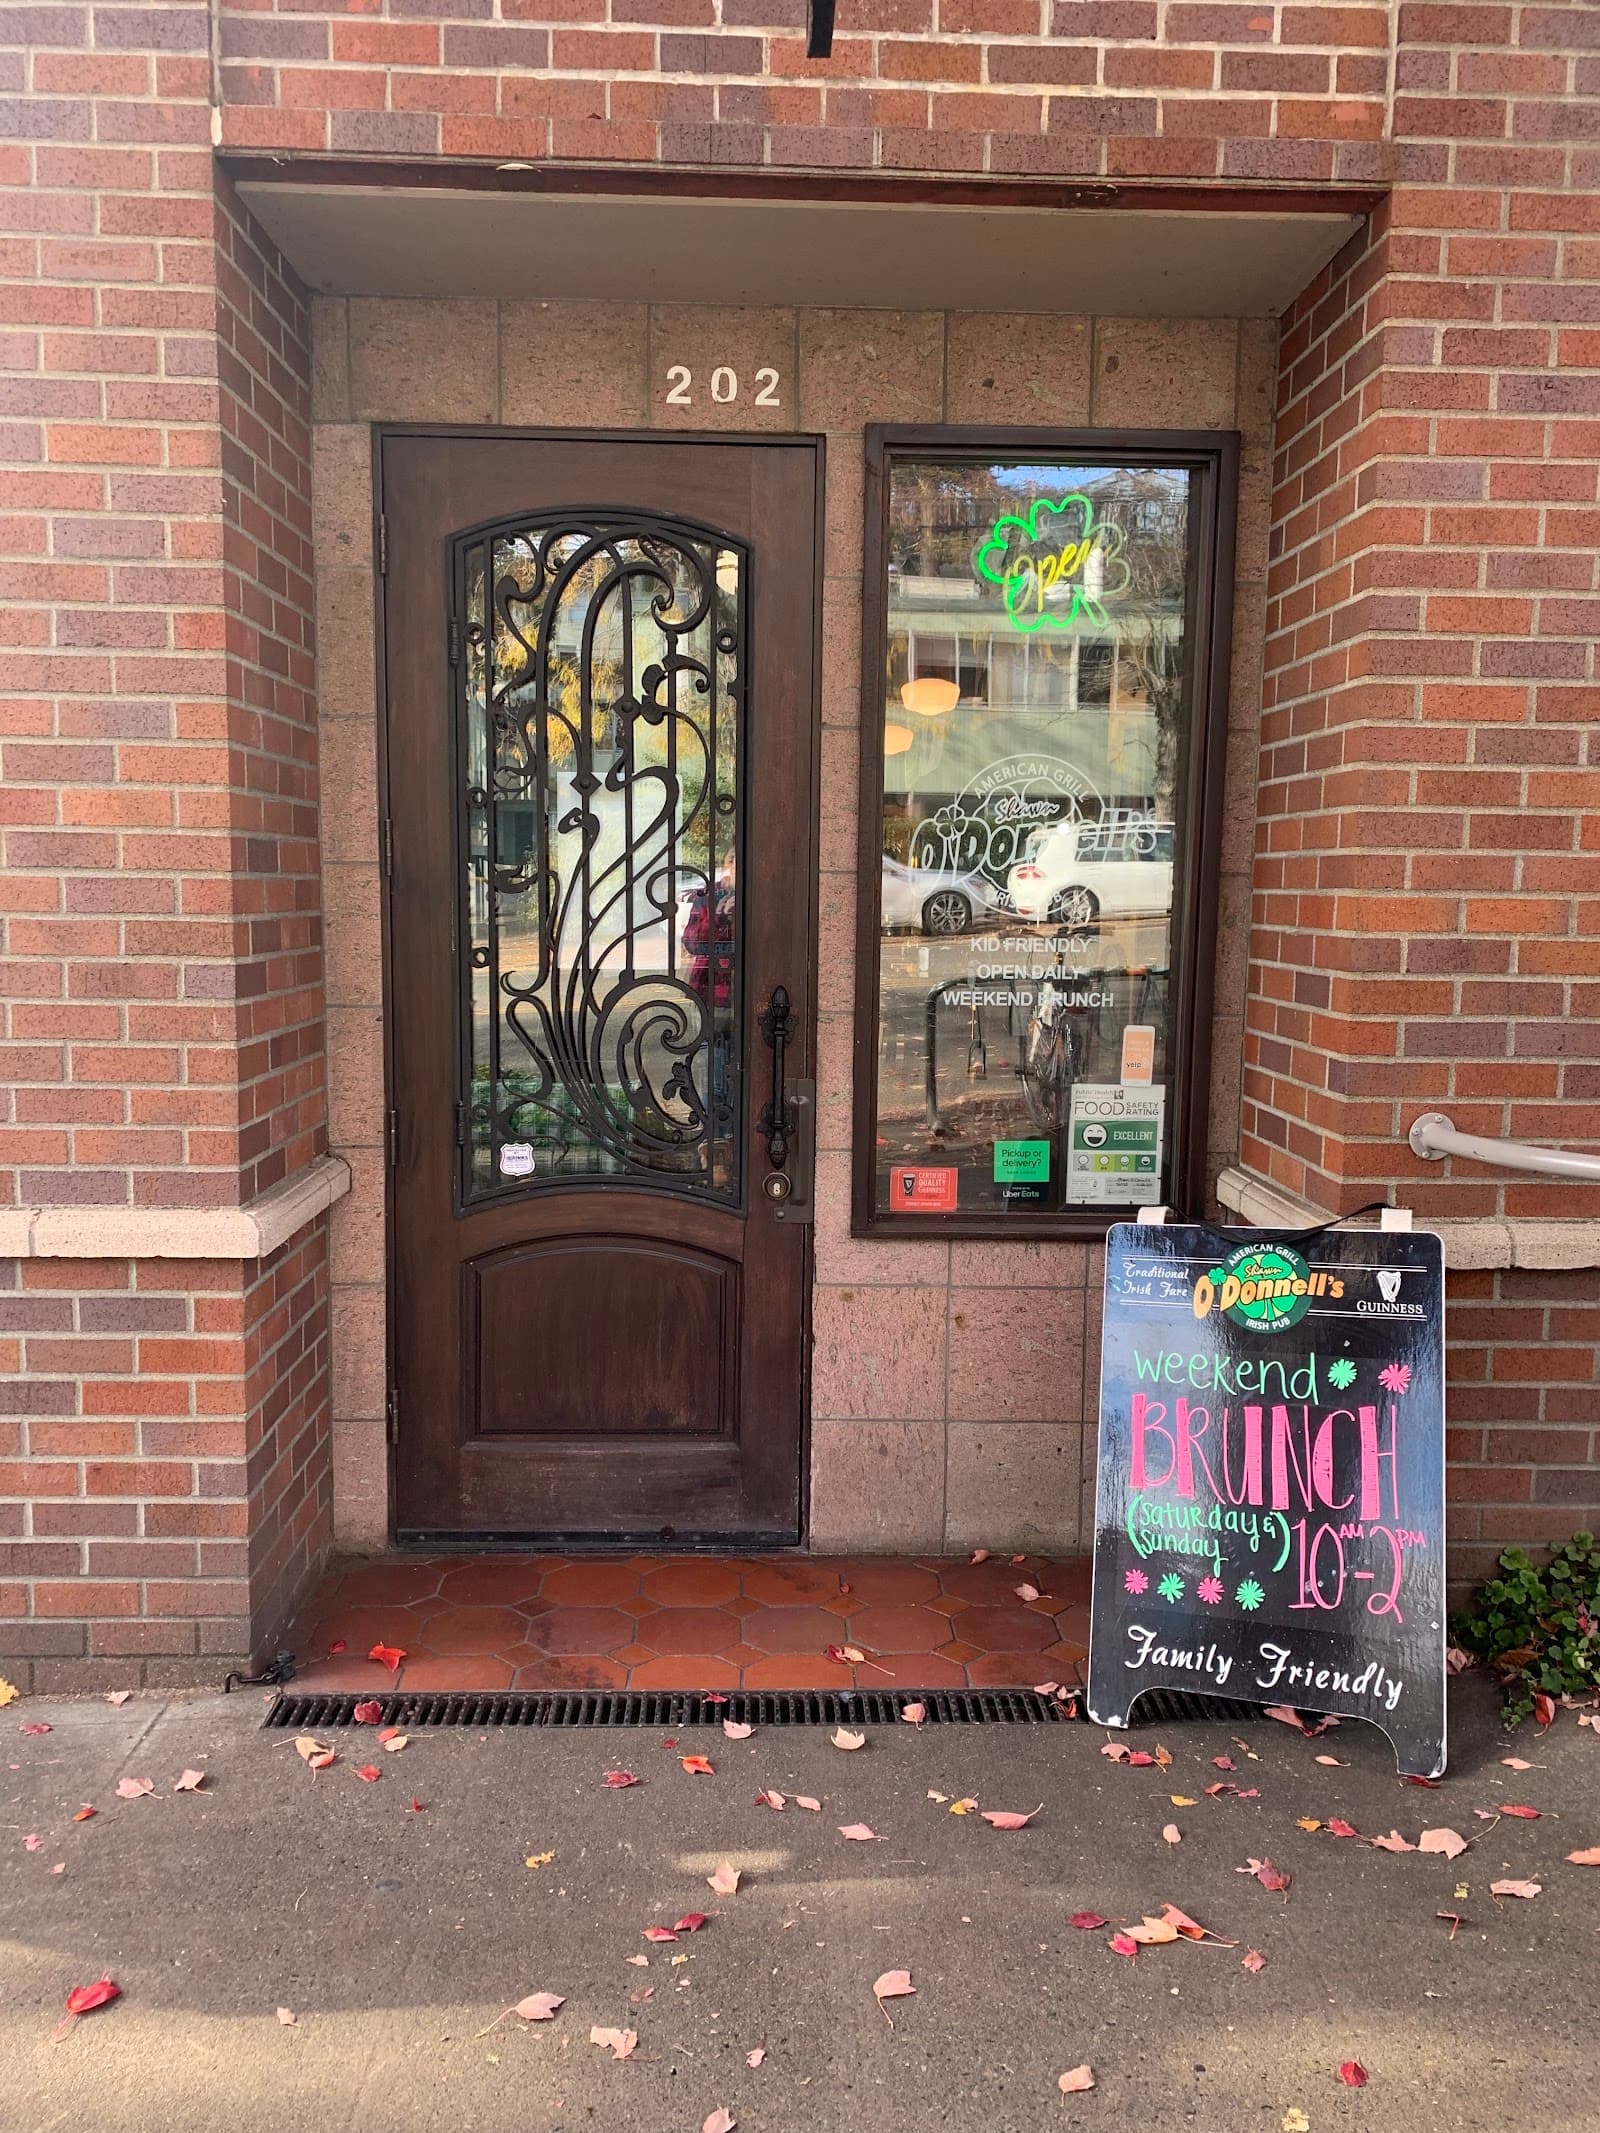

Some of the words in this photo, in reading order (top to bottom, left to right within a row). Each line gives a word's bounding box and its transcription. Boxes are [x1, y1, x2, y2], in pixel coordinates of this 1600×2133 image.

[666, 365, 780, 406] 202
[974, 762, 1049, 799] AMERICAN
[1053, 769, 1089, 803] GRILL
[994, 795, 1060, 824] Shawn
[970, 937, 1000, 952] KID
[1005, 937, 1091, 953] FRIENDLY
[976, 964, 1026, 979] OPEN
[1031, 965, 1082, 980] DAILY
[943, 991, 1033, 1006] WEEKEND
[1037, 992, 1114, 1008] BRUNCH
[1126, 1061, 1142, 1069] yelp
[1075, 1101, 1125, 1115] FOOD
[1125, 1108, 1159, 1116] RATING
[1113, 1131, 1153, 1141] EXCELLENT
[1001, 1149, 1031, 1159] Pickup
[1001, 1159, 1042, 1168] delivery?
[918, 1179, 946, 1187] QUALITY
[1002, 1190, 1020, 1198] Uber
[1021, 1190, 1040, 1198] Eats
[1228, 1243, 1274, 1267] AMERICAN
[1275, 1246, 1300, 1266] GRILL
[1122, 1262, 1189, 1279] Traditional
[1244, 1263, 1283, 1278] Shawn
[1122, 1280, 1152, 1296] Irish
[1160, 1281, 1188, 1298] Fare
[1356, 1299, 1424, 1315] GUINNESS
[1245, 1318, 1269, 1331] IRISH
[1272, 1317, 1291, 1330] PUB
[1129, 1393, 1399, 1521] BRUNCH
[1125, 1625, 1233, 1684] Family
[1255, 1642, 1404, 1710] Friendly
